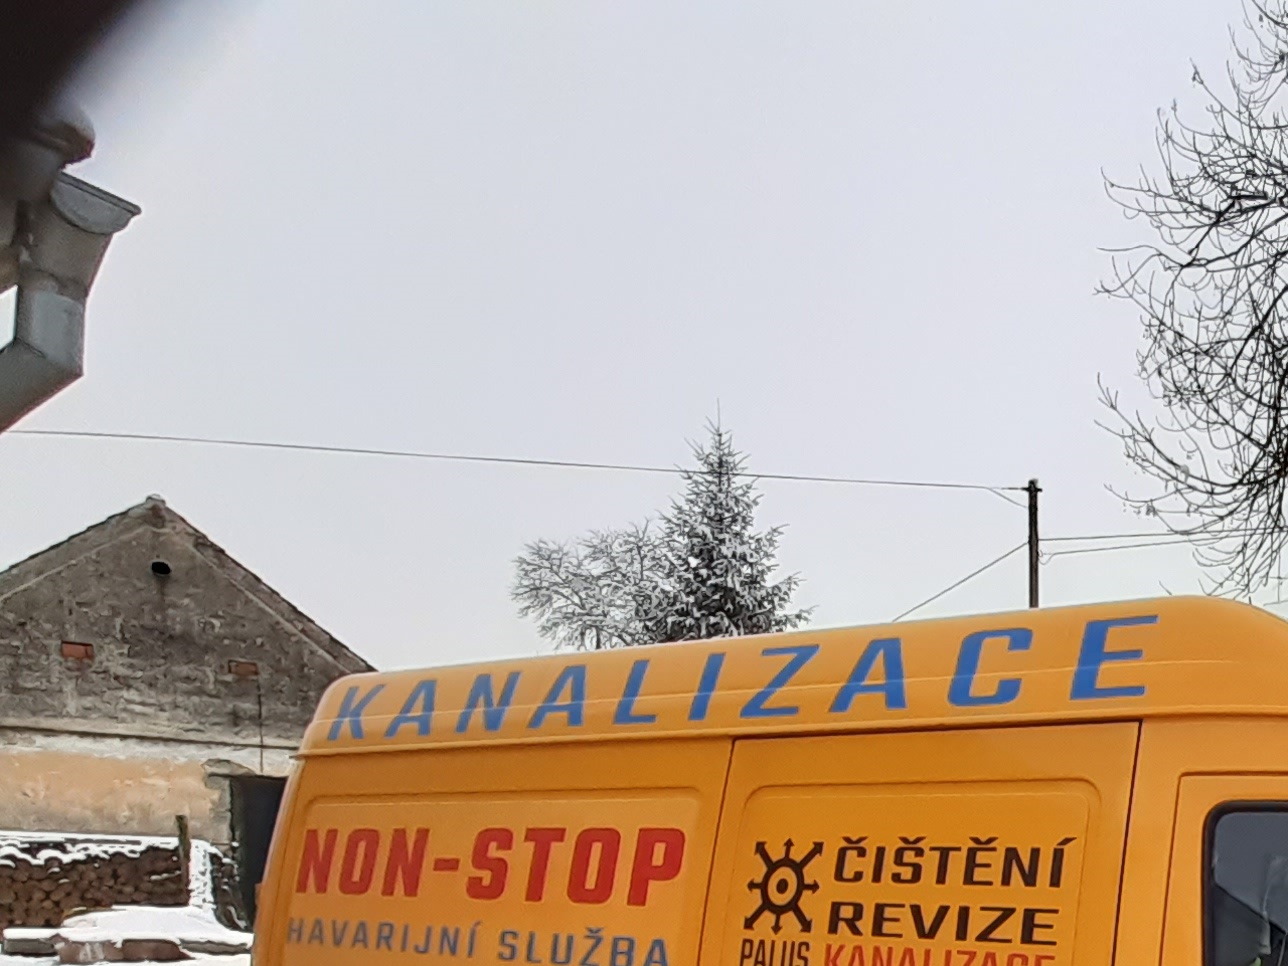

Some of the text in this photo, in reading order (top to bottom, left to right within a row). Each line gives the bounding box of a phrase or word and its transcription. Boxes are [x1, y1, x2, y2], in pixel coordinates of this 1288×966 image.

[327, 615, 1159, 741] KANALIZACE
[296, 827, 686, 907] NON-STOP
[833, 836, 1078, 889] ČIŠTĚNÍ
[287, 917, 481, 960] HAVARIJNÍ
[827, 902, 1060, 946] REVIZE
